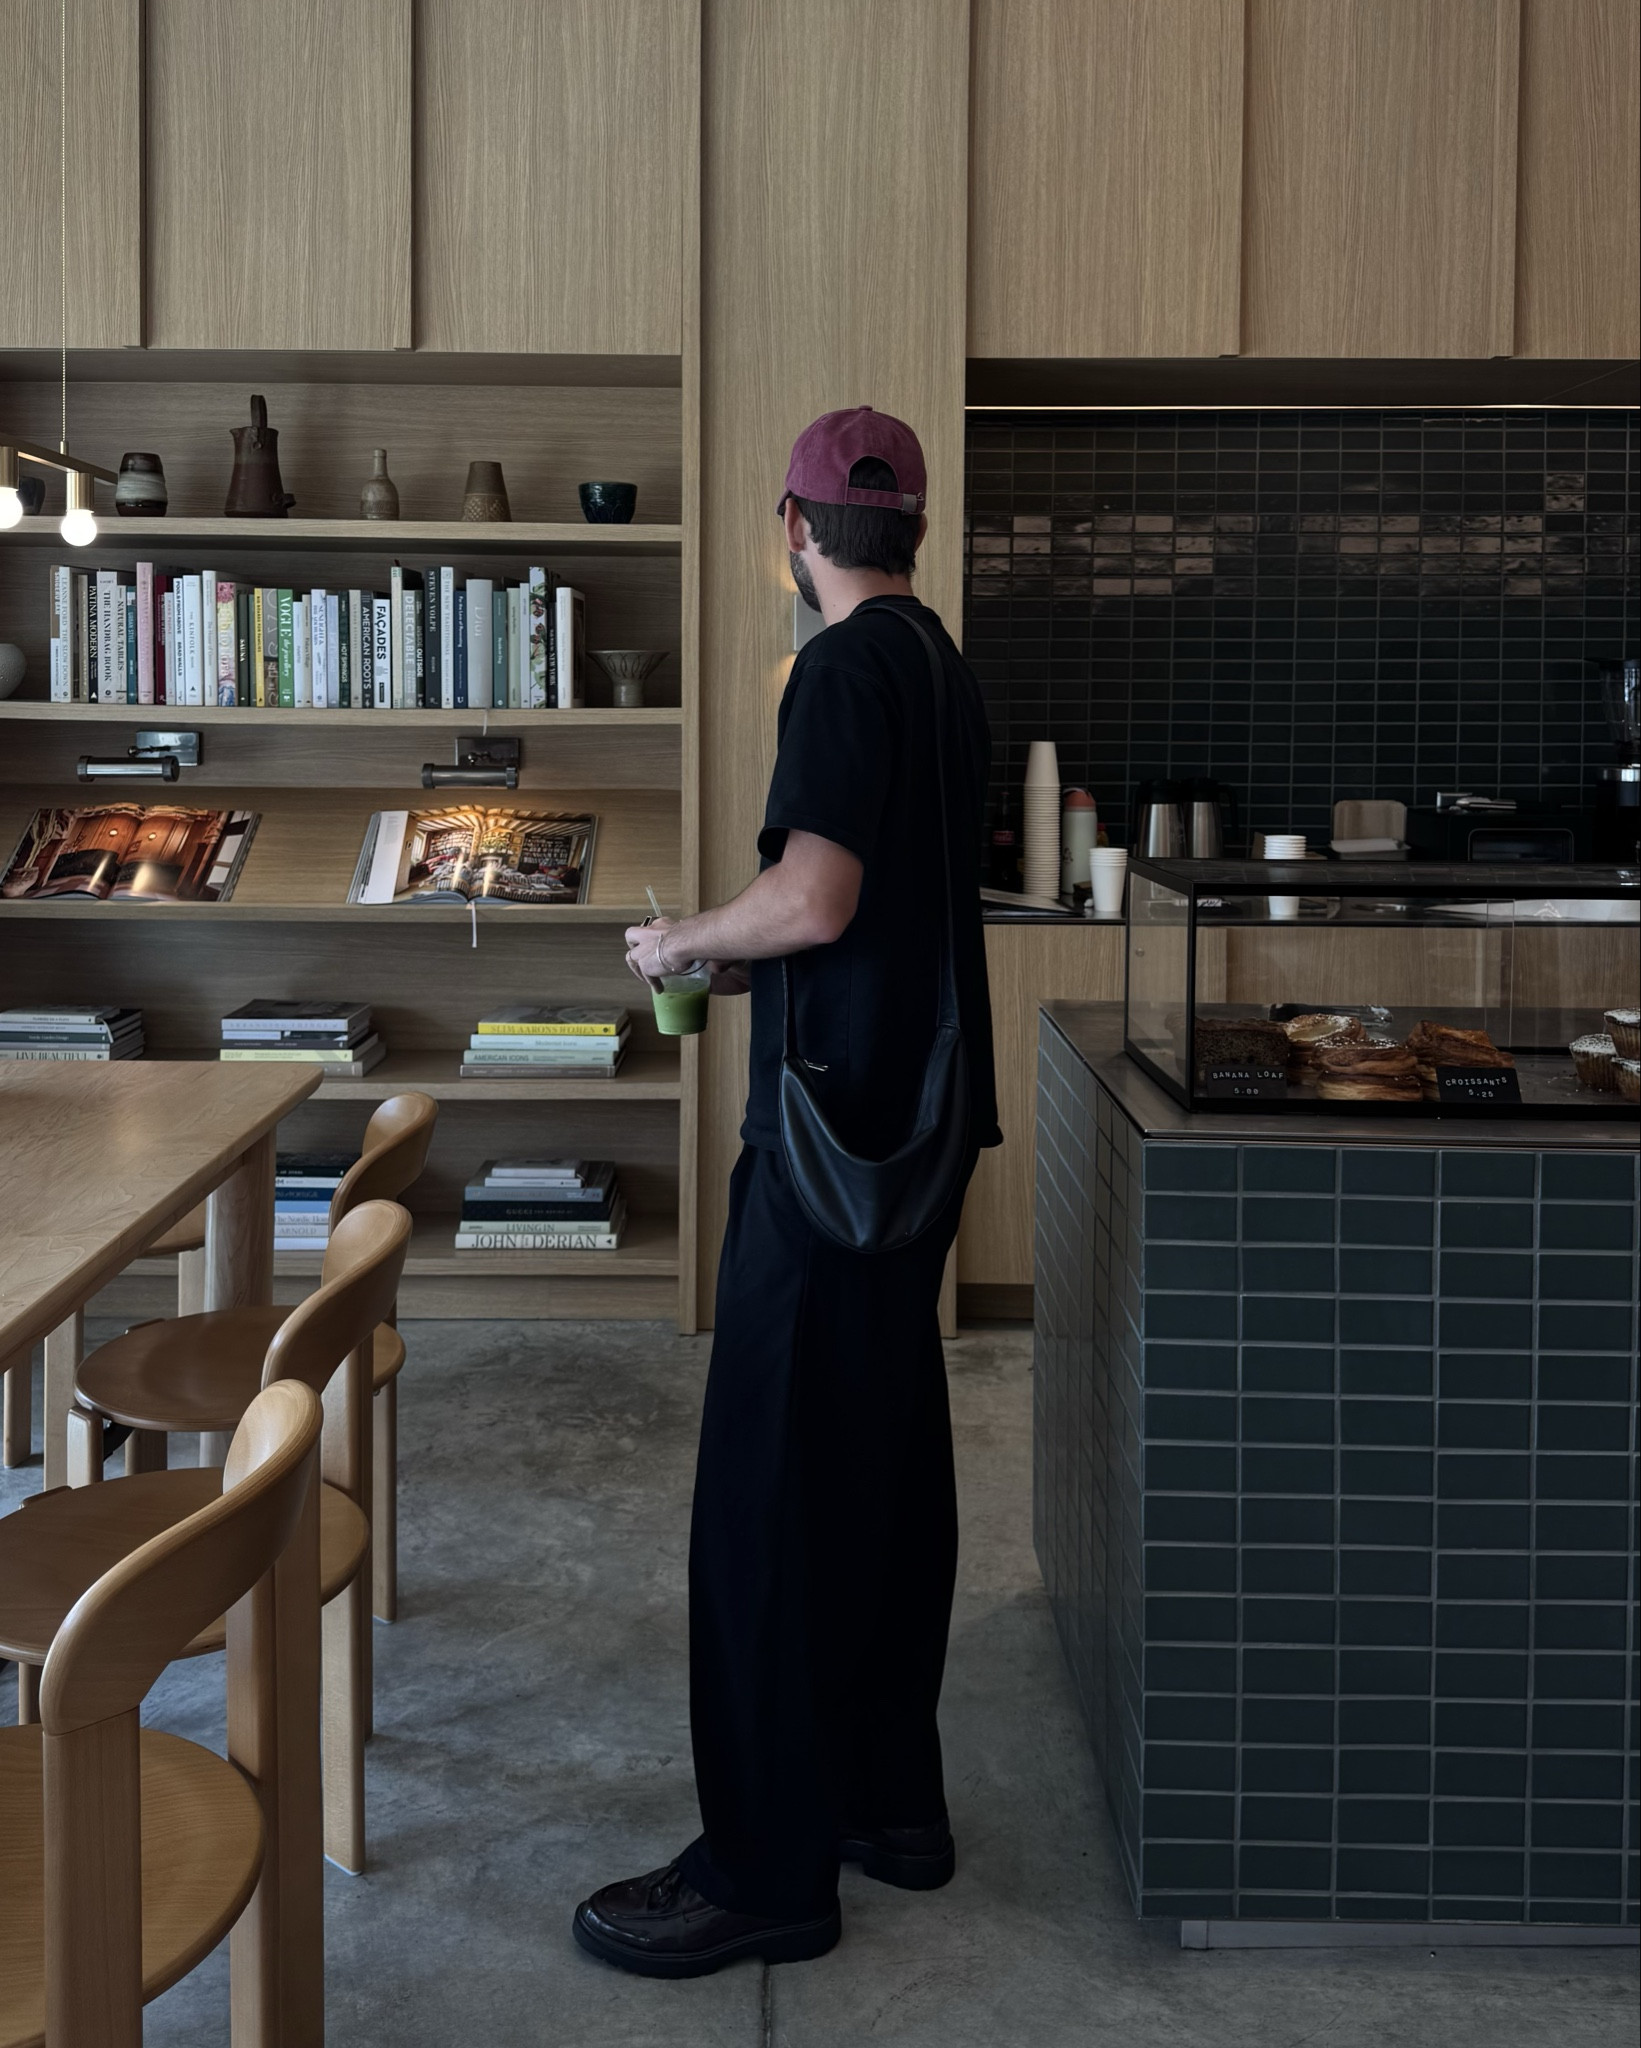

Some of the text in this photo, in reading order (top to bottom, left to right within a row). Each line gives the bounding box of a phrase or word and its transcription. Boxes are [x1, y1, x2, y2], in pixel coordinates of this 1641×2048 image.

[428, 570, 436, 603] STEVEN
[89, 585, 97, 618] PATINA
[103, 591, 112, 609] THE
[280, 596, 292, 637] VOGUE
[429, 605, 437, 632] VOLPE
[474, 606, 488, 637] Dior
[89, 619, 98, 658] MODERN
[103, 610, 112, 654] HANDBAG
[117, 600, 125, 672] NATURAL TABLES
[375, 606, 387, 660] FAÇADES
[405, 596, 414, 664] DELECTABLE
[283, 639, 291, 649] the
[362, 606, 371, 690] AMERICAN ROOTS
[103, 656, 112, 682] BOOK
[549, 668, 557, 686] YORK
[491, 1025, 595, 1034] SLIM AARONS WOMEN
[16, 1051, 89, 1061] LIVE BEAUTIFUL
[473, 1054, 507, 1062] AMERICAN
[509, 1054, 529, 1062] ICONS
[1212, 1070, 1284, 1079] BANANA LOAF
[1445, 1076, 1507, 1087] CROISSANTS
[1233, 1087, 1259, 1095] 5.00
[1468, 1088, 1494, 1098] 5.25
[506, 1208, 533, 1216] GUCCI
[505, 1223, 555, 1232] LIVING IN
[472, 1234, 517, 1248] JOHN
[533, 1234, 597, 1248] DERIAN
